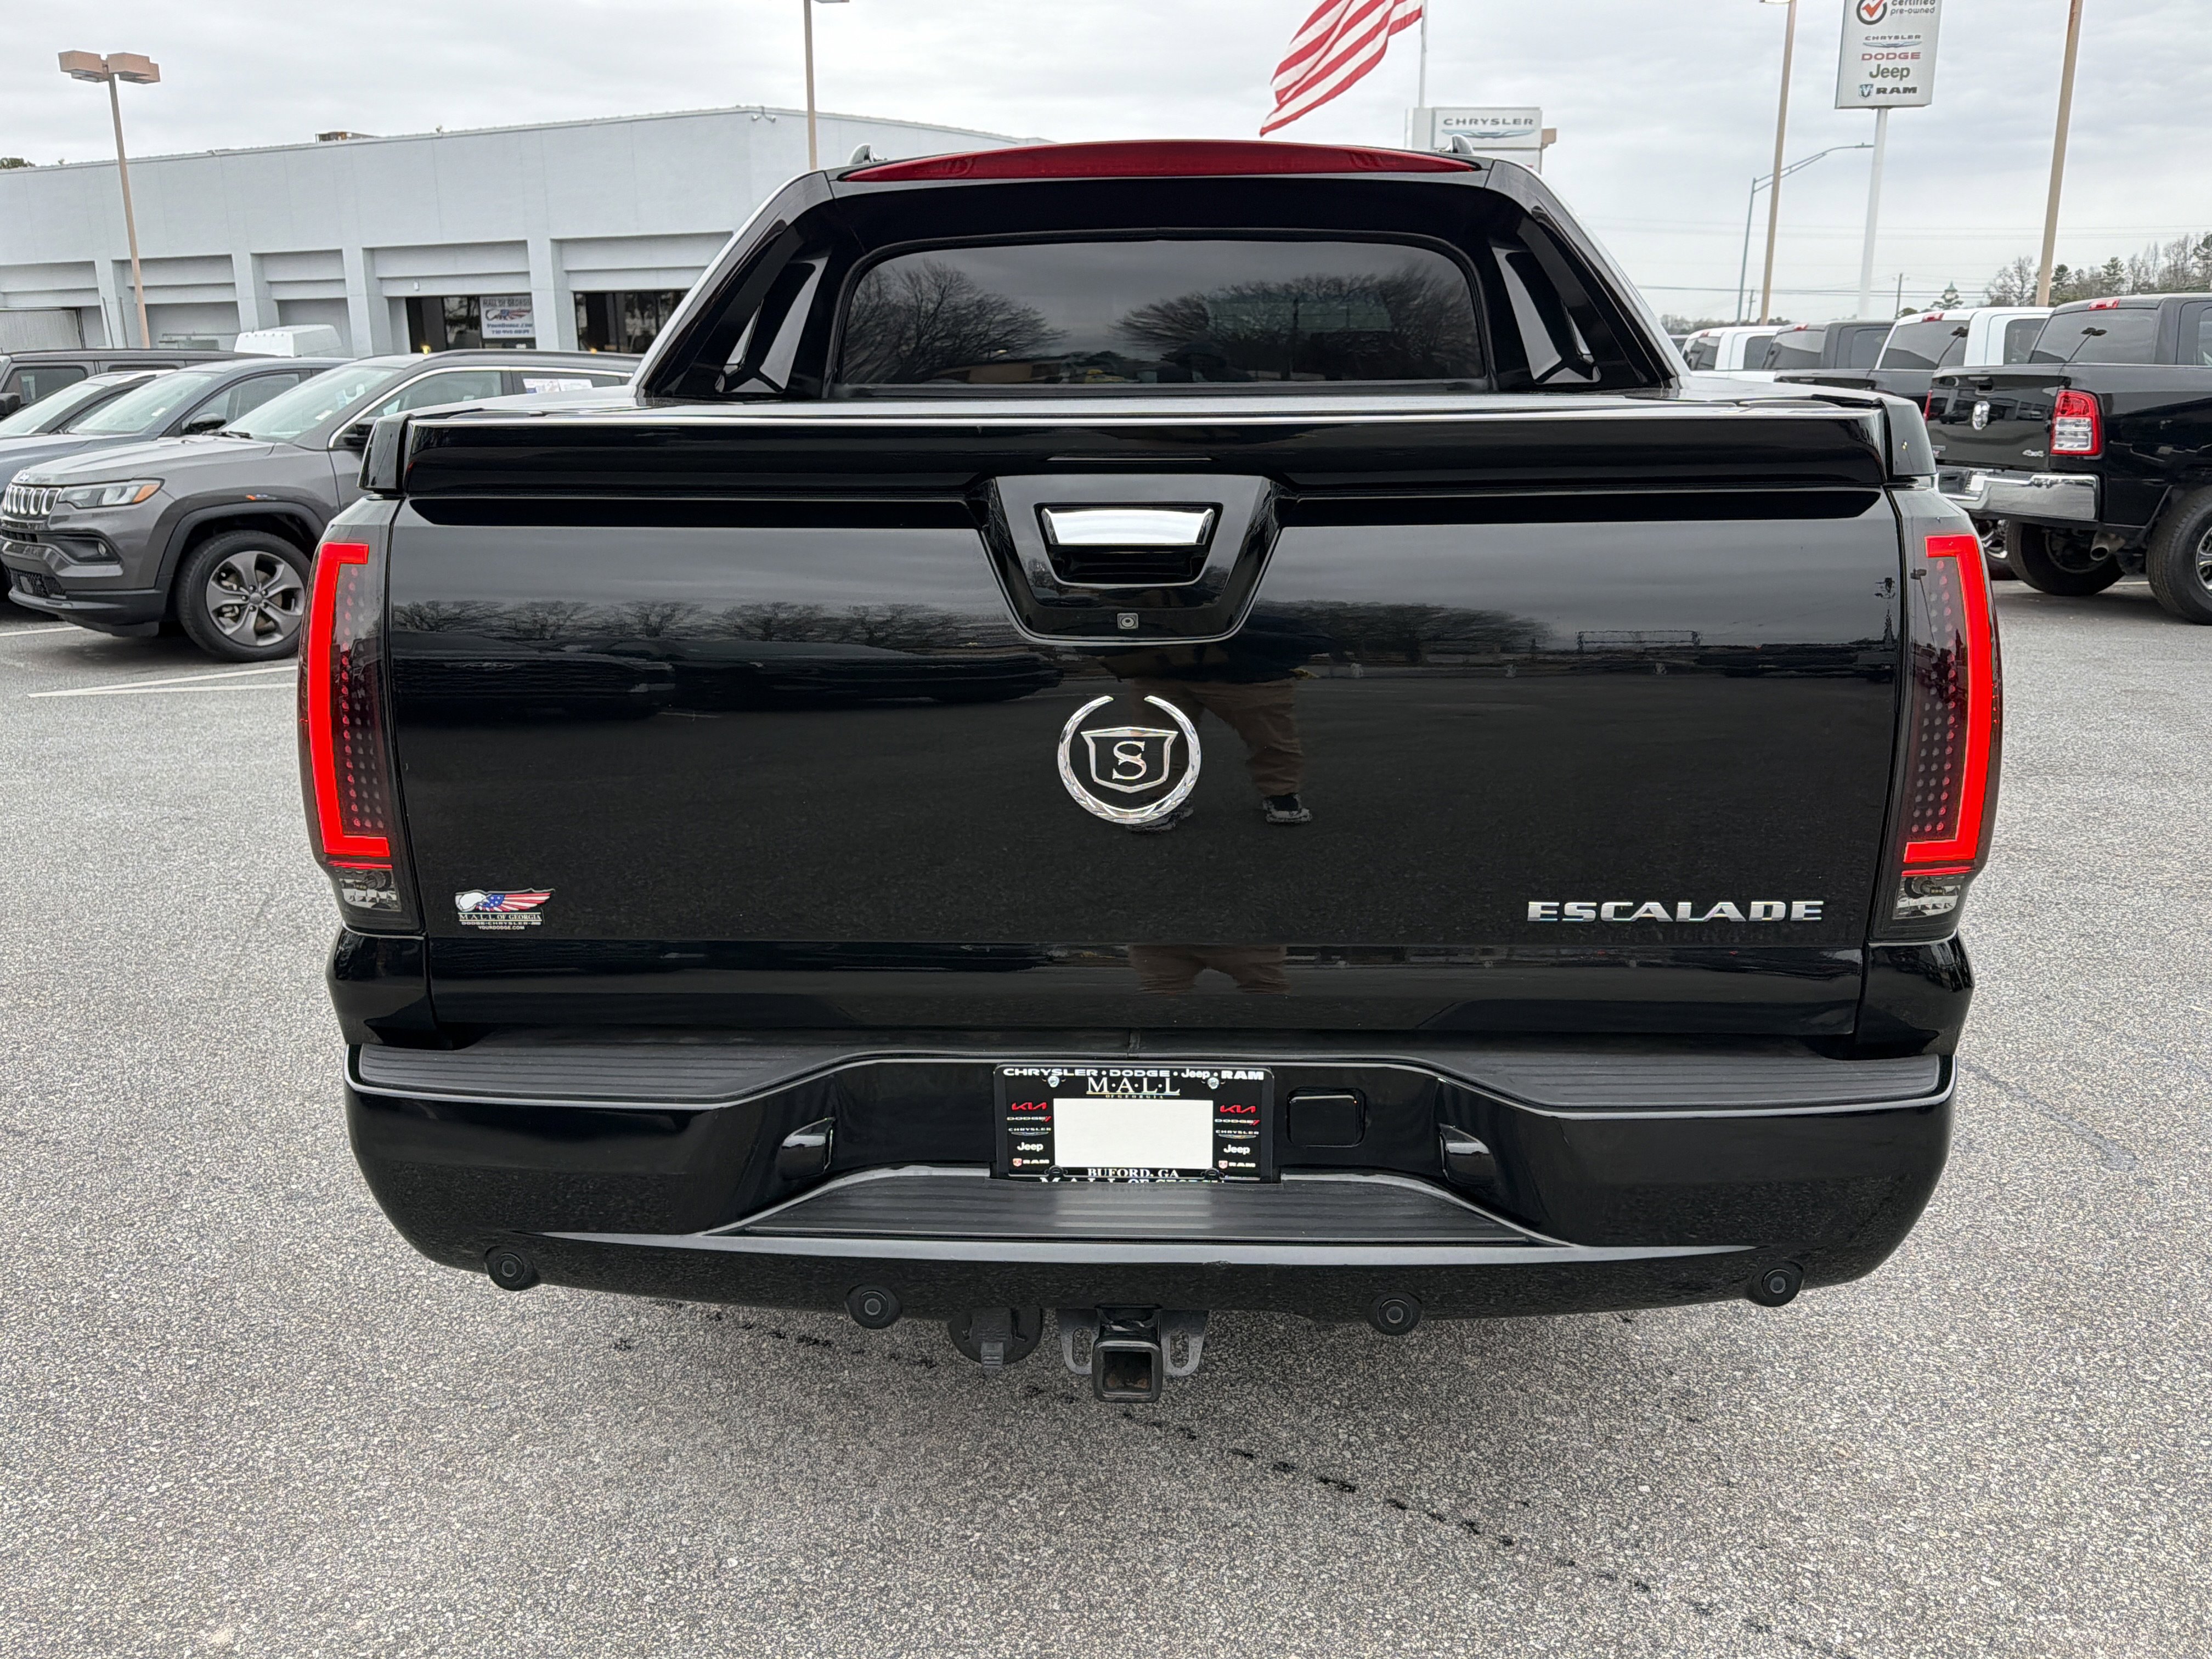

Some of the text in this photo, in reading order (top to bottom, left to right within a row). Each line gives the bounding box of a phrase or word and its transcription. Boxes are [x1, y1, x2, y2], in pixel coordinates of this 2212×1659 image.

[1890, 7, 1936, 16] pre-owned
[1861, 52, 1921, 61] DODGE
[1869, 64, 1910, 81] Jeep
[1112, 741, 1147, 780] S
[1527, 901, 1824, 922] ESCALADE
[1003, 1068, 1098, 1076] CHRYSLER
[1181, 1069, 1211, 1079] Jeep
[1221, 1070, 1264, 1080] RAM
[1017, 1142, 1043, 1152] Jeep
[1223, 1144, 1250, 1155] Jeep
[1158, 1169, 1179, 1177] GA
